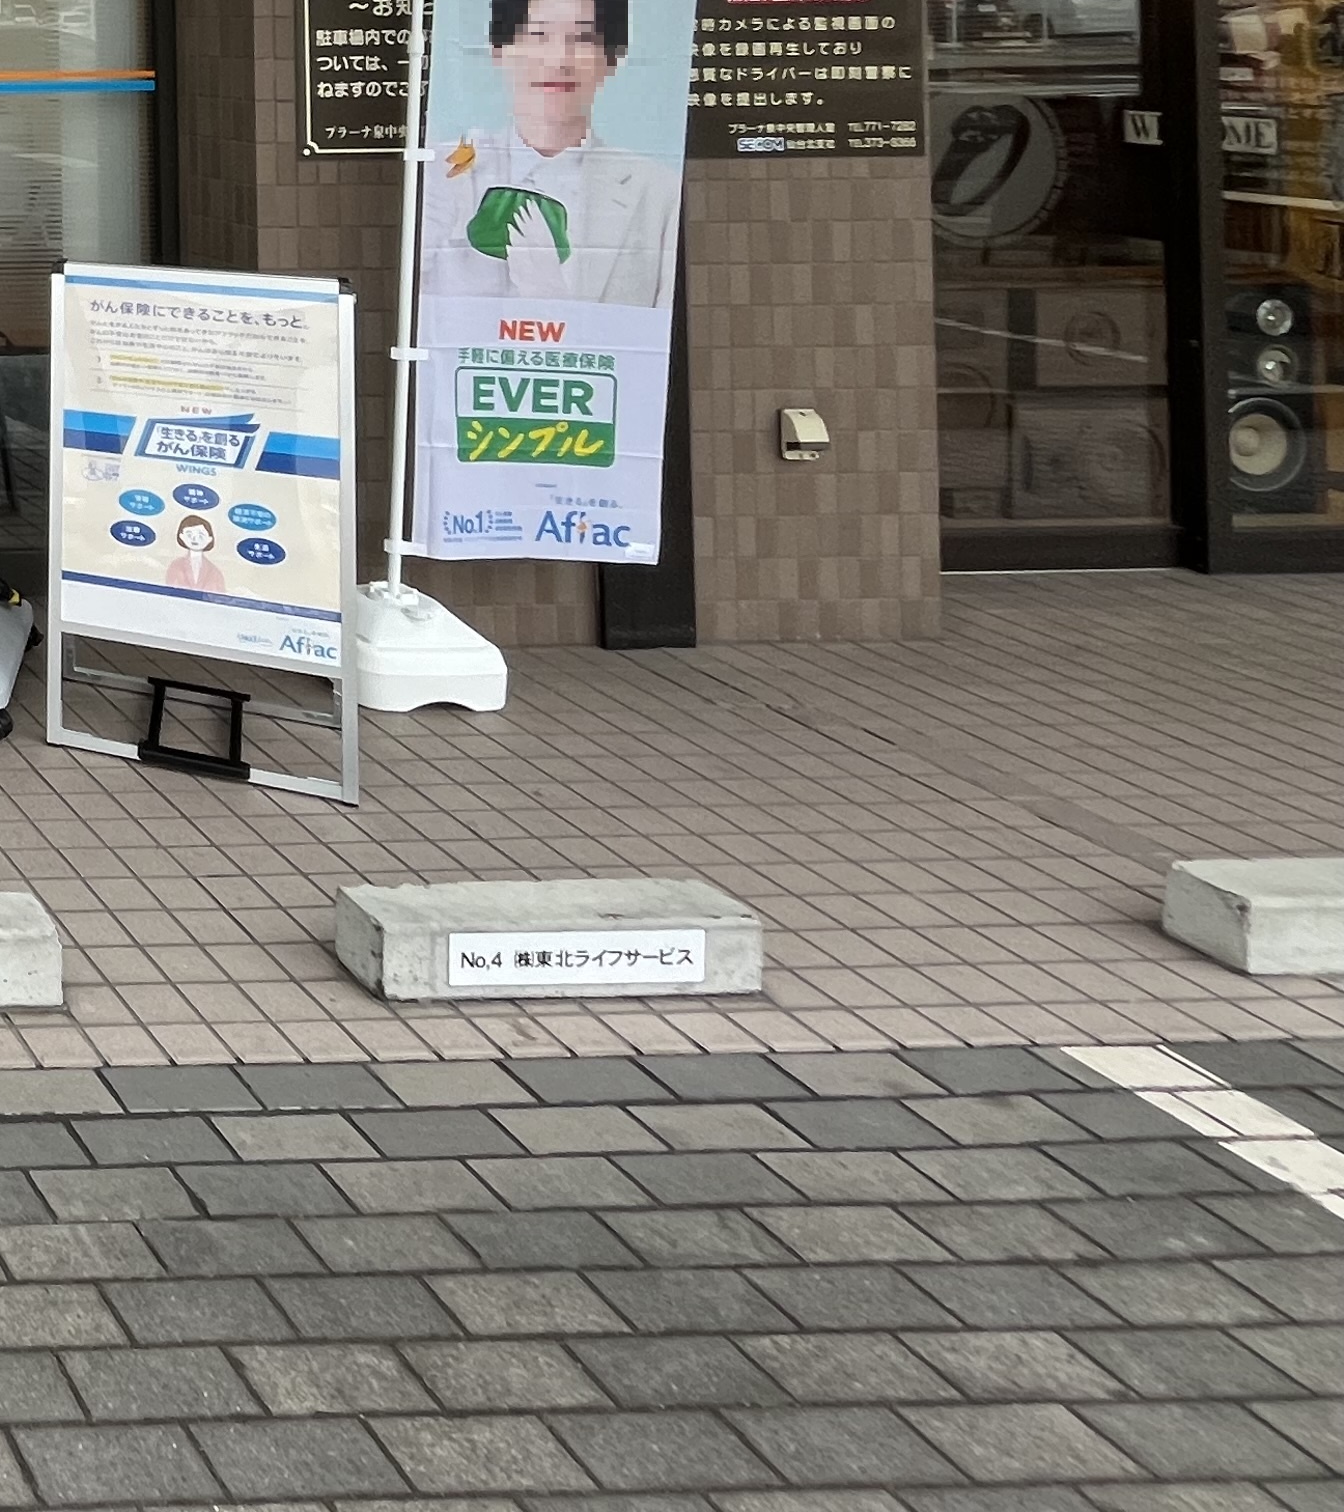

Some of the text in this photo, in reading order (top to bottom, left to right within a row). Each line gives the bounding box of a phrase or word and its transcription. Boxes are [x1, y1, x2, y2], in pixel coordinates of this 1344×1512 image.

[499, 319, 565, 343] NEW
[458, 346, 616, 371] 手軽に備える医療保険
[472, 375, 593, 417] EVER
[180, 405, 212, 415] NEW
[156, 440, 227, 461] がん保険
[467, 420, 604, 461] シンプル
[175, 463, 217, 477] WINGS
